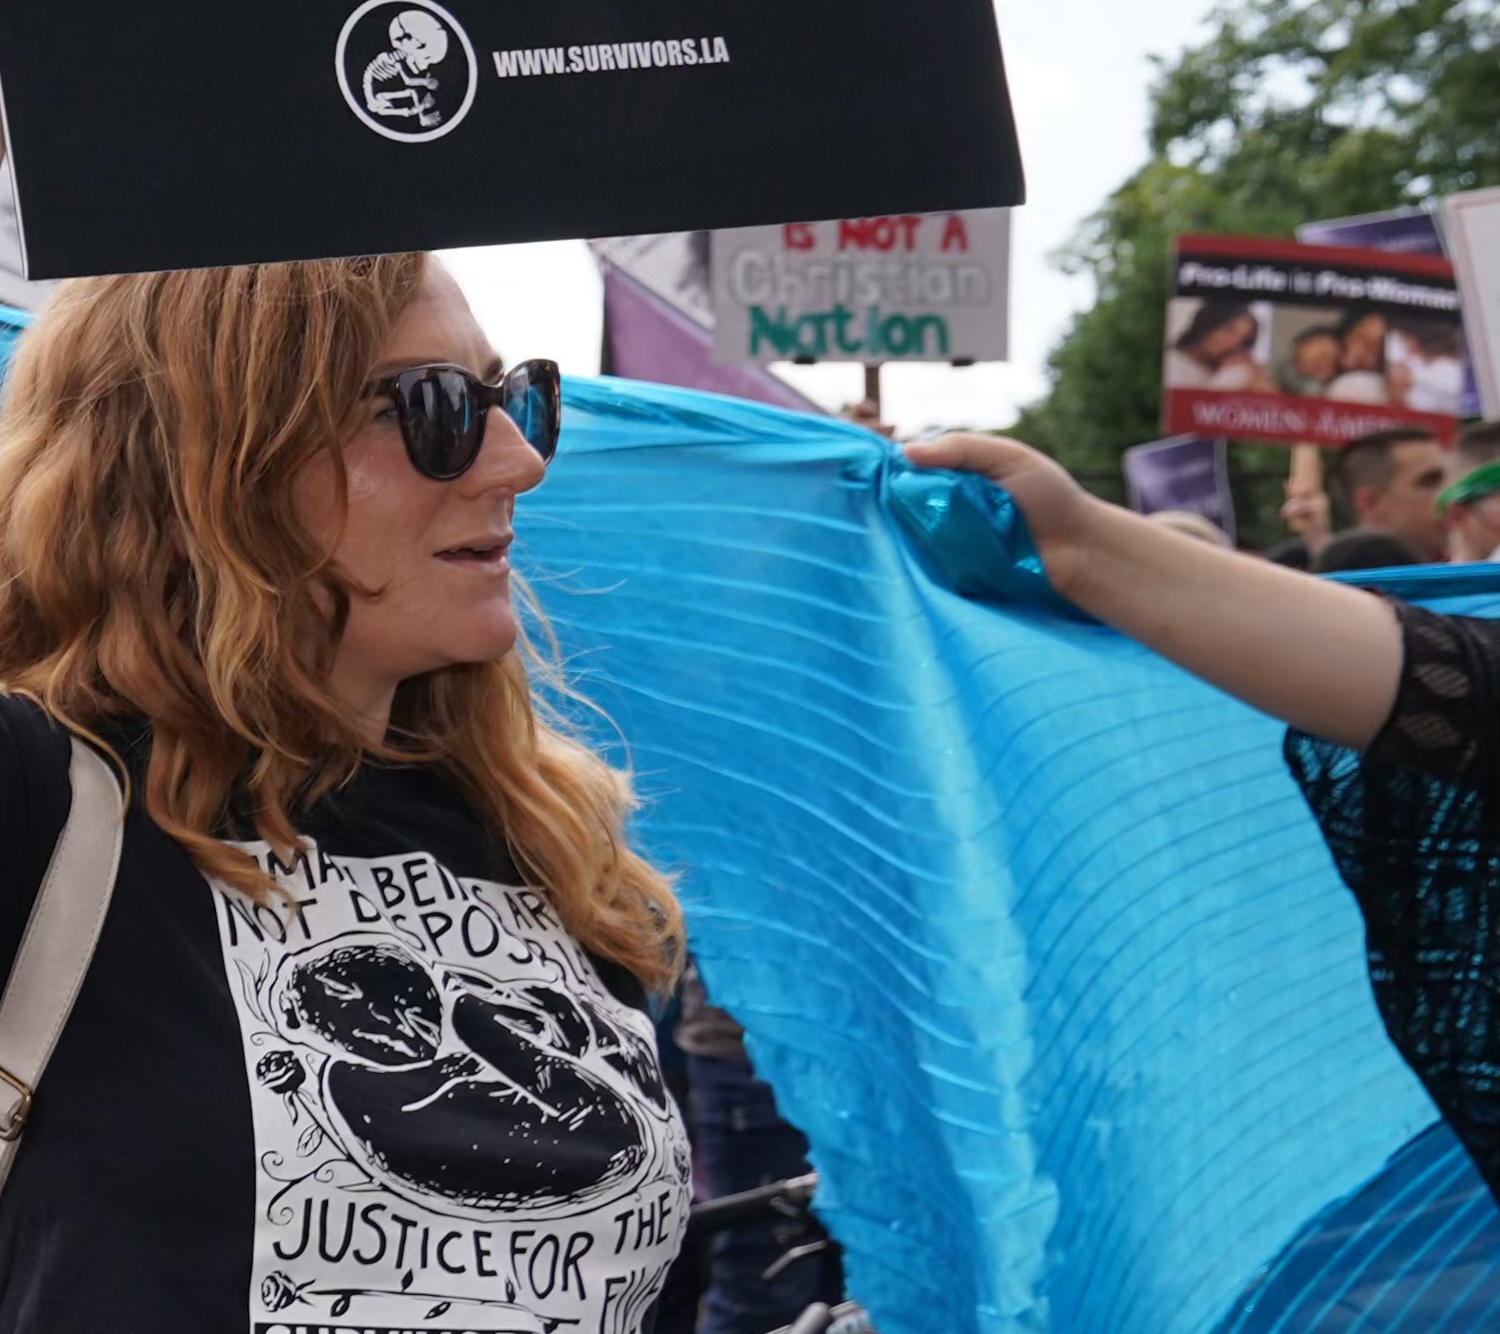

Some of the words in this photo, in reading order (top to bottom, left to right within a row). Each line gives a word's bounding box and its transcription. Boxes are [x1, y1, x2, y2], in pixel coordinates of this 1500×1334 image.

[492, 36, 730, 78] WWW.SURVIVORS.LA
[782, 223, 816, 251] IS
[838, 215, 923, 253] NOT
[940, 215, 970, 252] A
[748, 305, 950, 357] Nation
[273, 1198, 498, 1278] JUSTICE
[510, 1229, 595, 1301] FOR
[613, 1188, 673, 1255] THE
